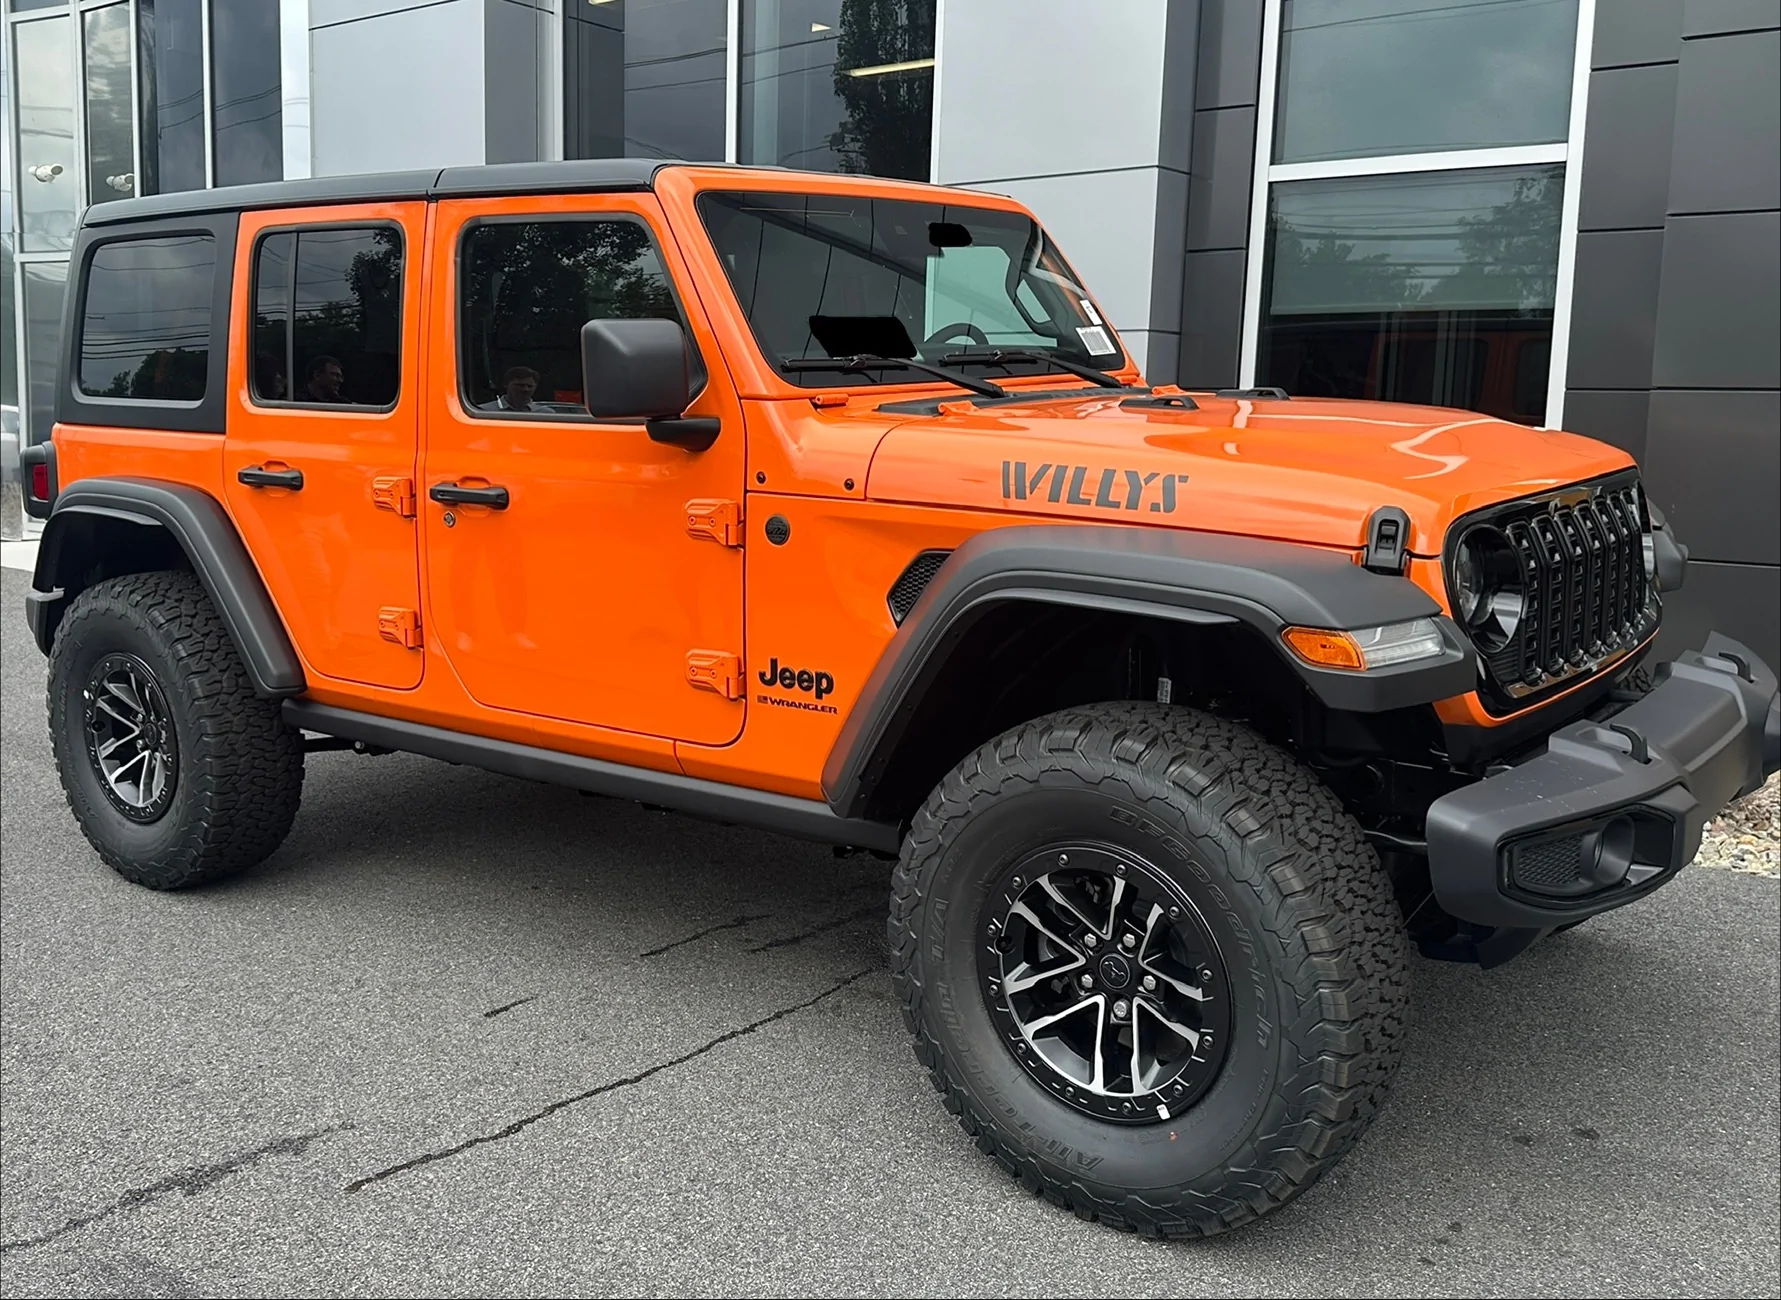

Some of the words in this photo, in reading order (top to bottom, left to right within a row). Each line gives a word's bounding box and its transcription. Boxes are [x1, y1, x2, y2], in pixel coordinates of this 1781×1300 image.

[1002, 461, 1189, 513] WILLYS
[758, 657, 834, 700] Jeep
[768, 696, 838, 714] WRANGLER
[928, 897, 950, 965] T/A
